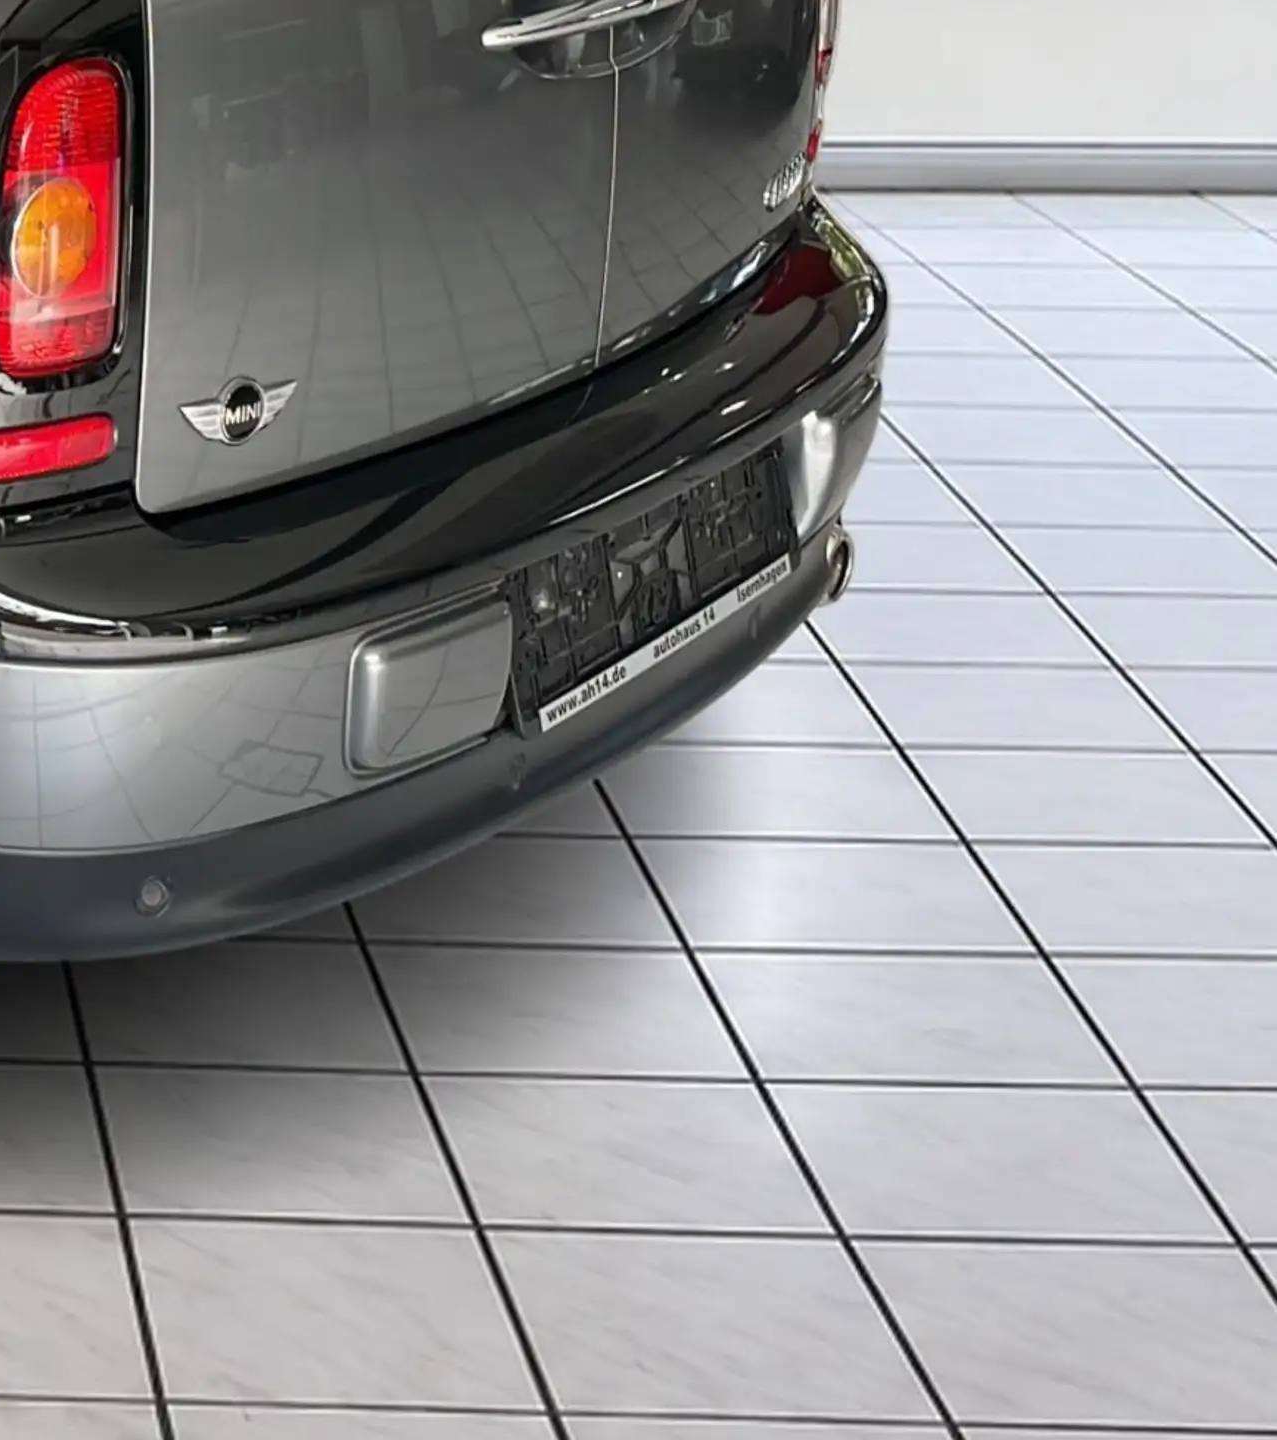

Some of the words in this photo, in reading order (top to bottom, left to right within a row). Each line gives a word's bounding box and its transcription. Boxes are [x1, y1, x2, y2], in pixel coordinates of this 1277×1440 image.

[225, 401, 261, 425] MINI
[546, 665, 627, 723] www.ah14.de
[652, 618, 701, 659] autohaus
[703, 606, 716, 627] 14
[736, 559, 788, 603] Isernhagen
